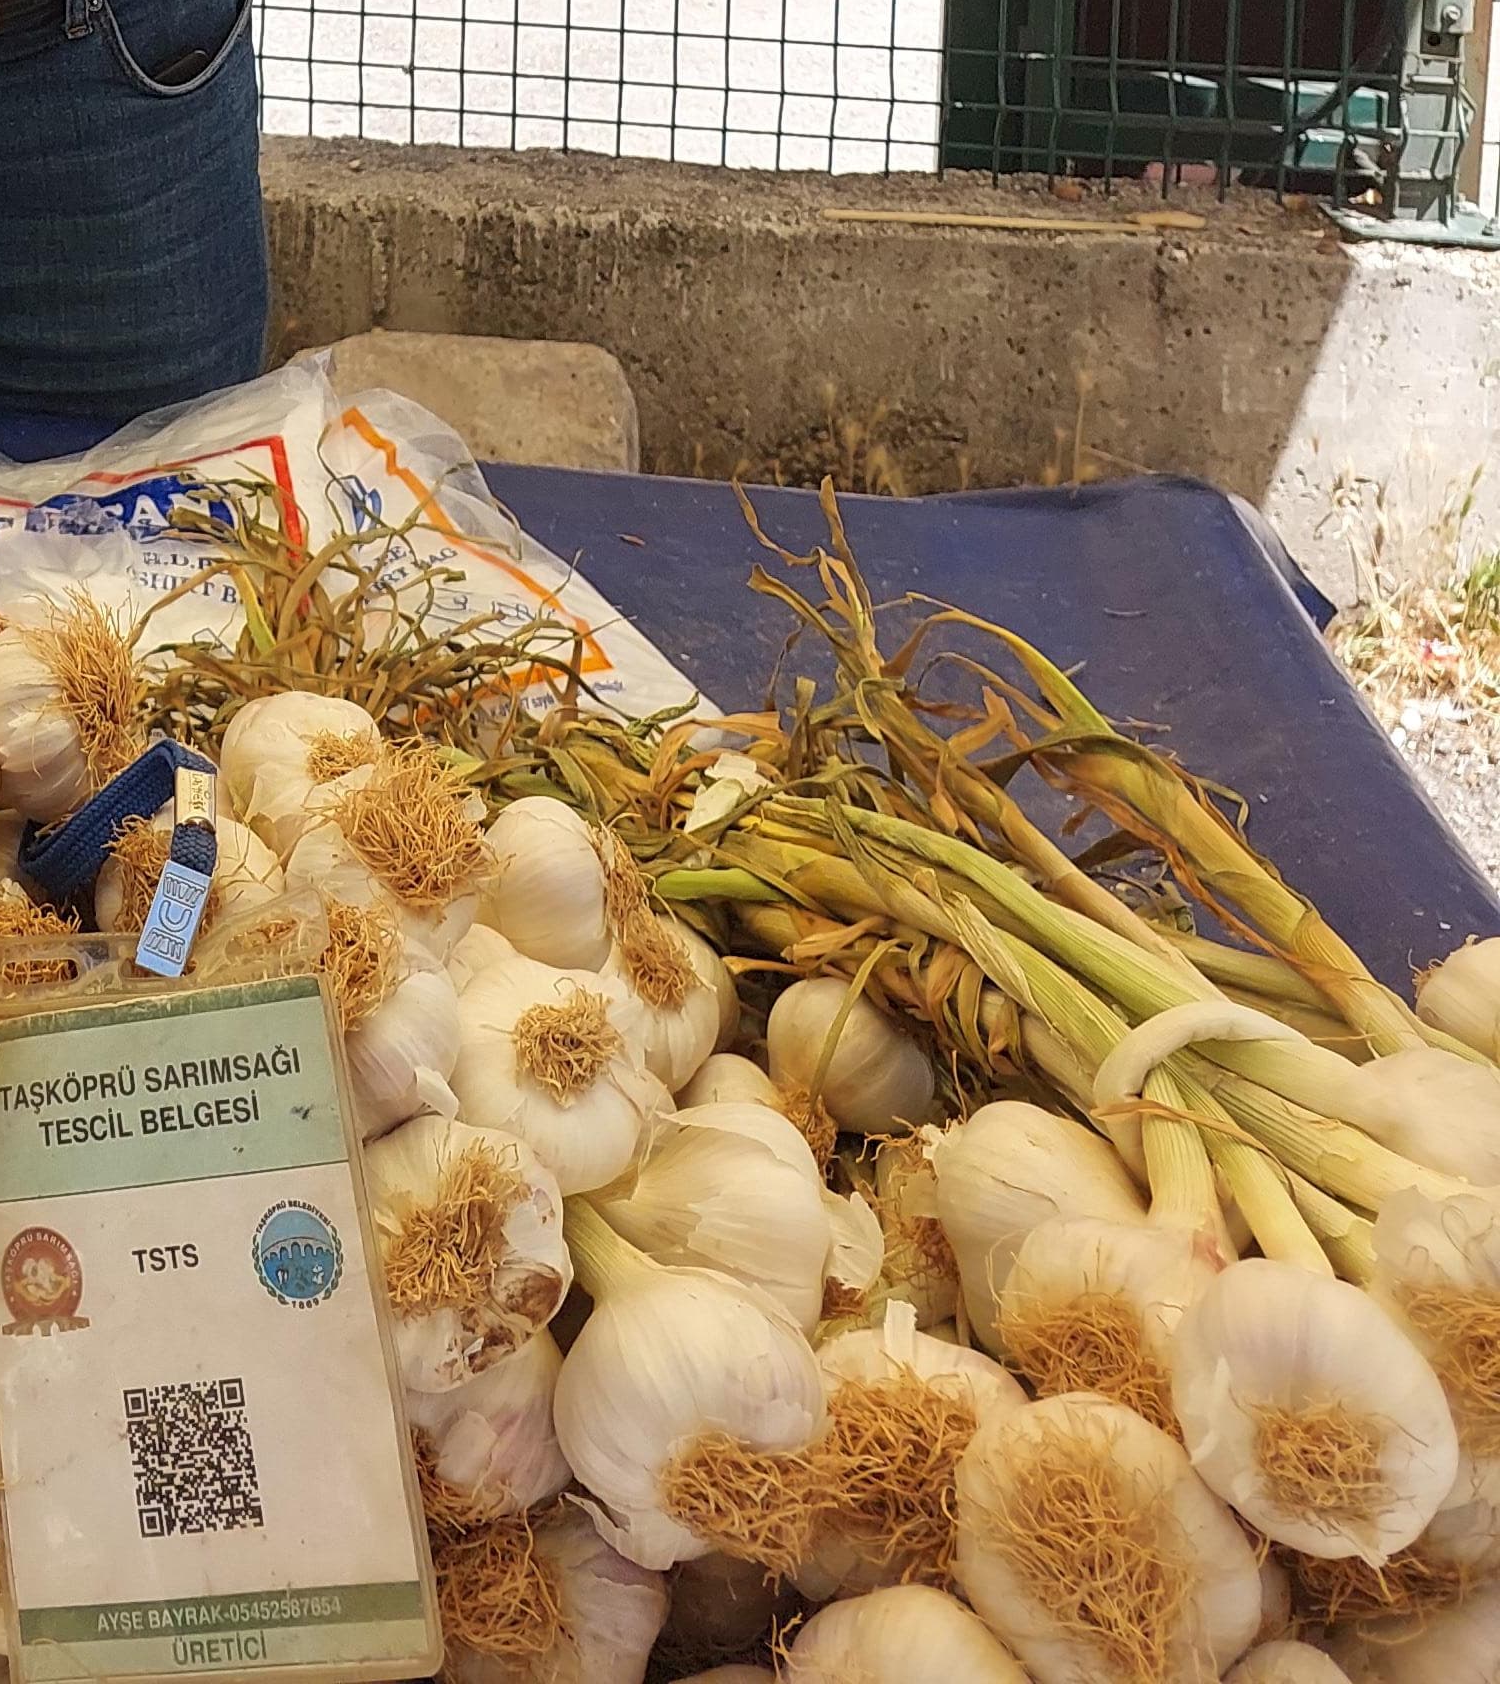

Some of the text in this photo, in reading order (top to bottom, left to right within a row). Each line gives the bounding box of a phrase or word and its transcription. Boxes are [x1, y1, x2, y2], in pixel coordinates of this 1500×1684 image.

[145, 1044, 301, 1093] SARIMSAĞI
[39, 1089, 260, 1147] TESCİL BELGESİ
[131, 1243, 199, 1273] TSTS
[97, 1611, 144, 1636] AYŞE
[172, 1630, 268, 1666] ÜRETİCİ
